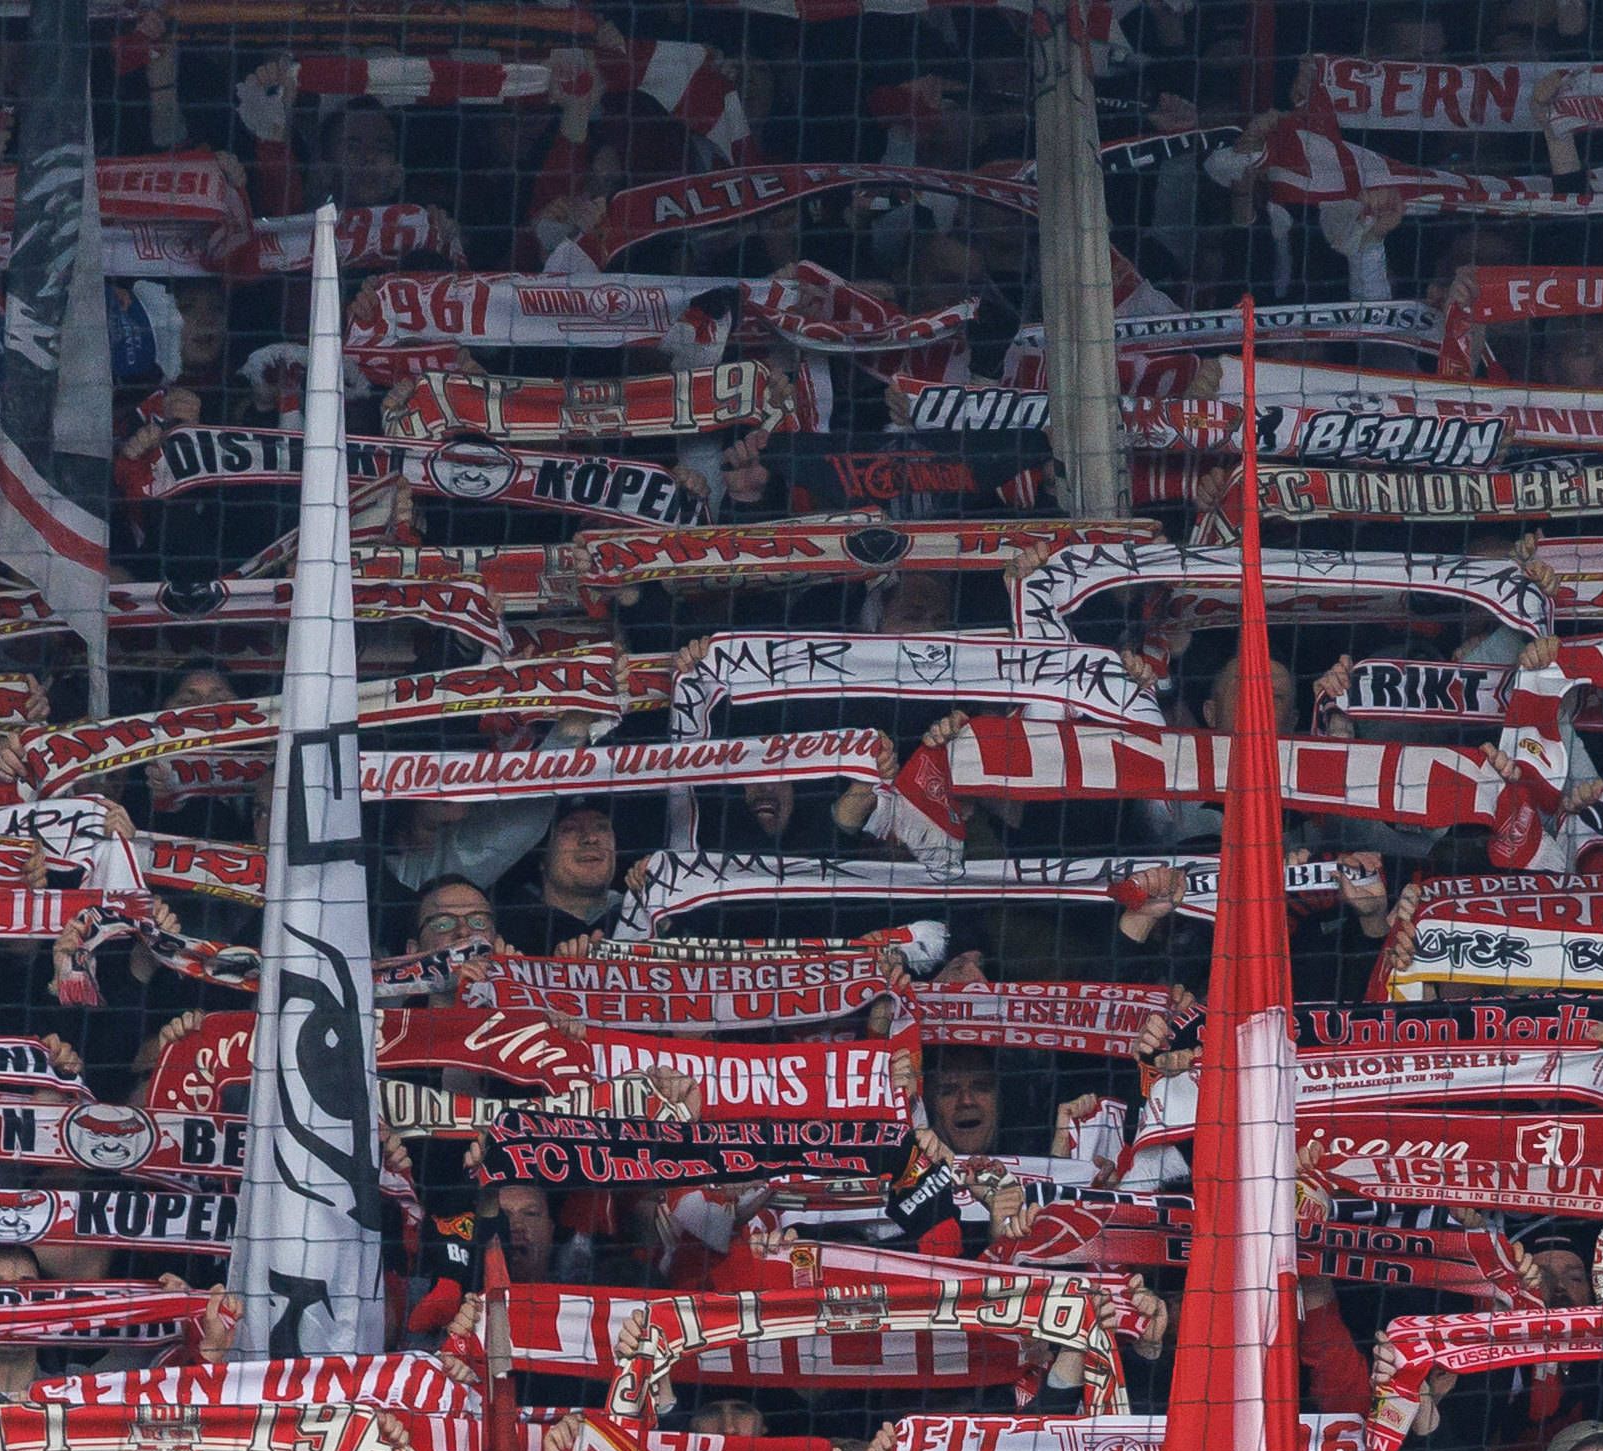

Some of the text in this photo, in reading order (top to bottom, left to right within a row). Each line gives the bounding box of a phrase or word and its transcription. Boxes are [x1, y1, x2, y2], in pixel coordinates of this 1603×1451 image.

[1506, 277, 1560, 312] FC
[1306, 409, 1504, 469] BERLIN
[1320, 469, 1501, 516] UNION
[605, 739, 751, 782] Union
[508, 959, 673, 992] NIEMALS
[1007, 1000, 1102, 1026] EISERN
[1312, 1008, 1463, 1048] Union
[1302, 1054, 1410, 1082] UNION
[513, 1144, 570, 1182] FC
[1376, 1156, 1530, 1193] EISERN
[898, 1164, 954, 1216] Berlin
[1402, 1316, 1590, 1358] EISERN
